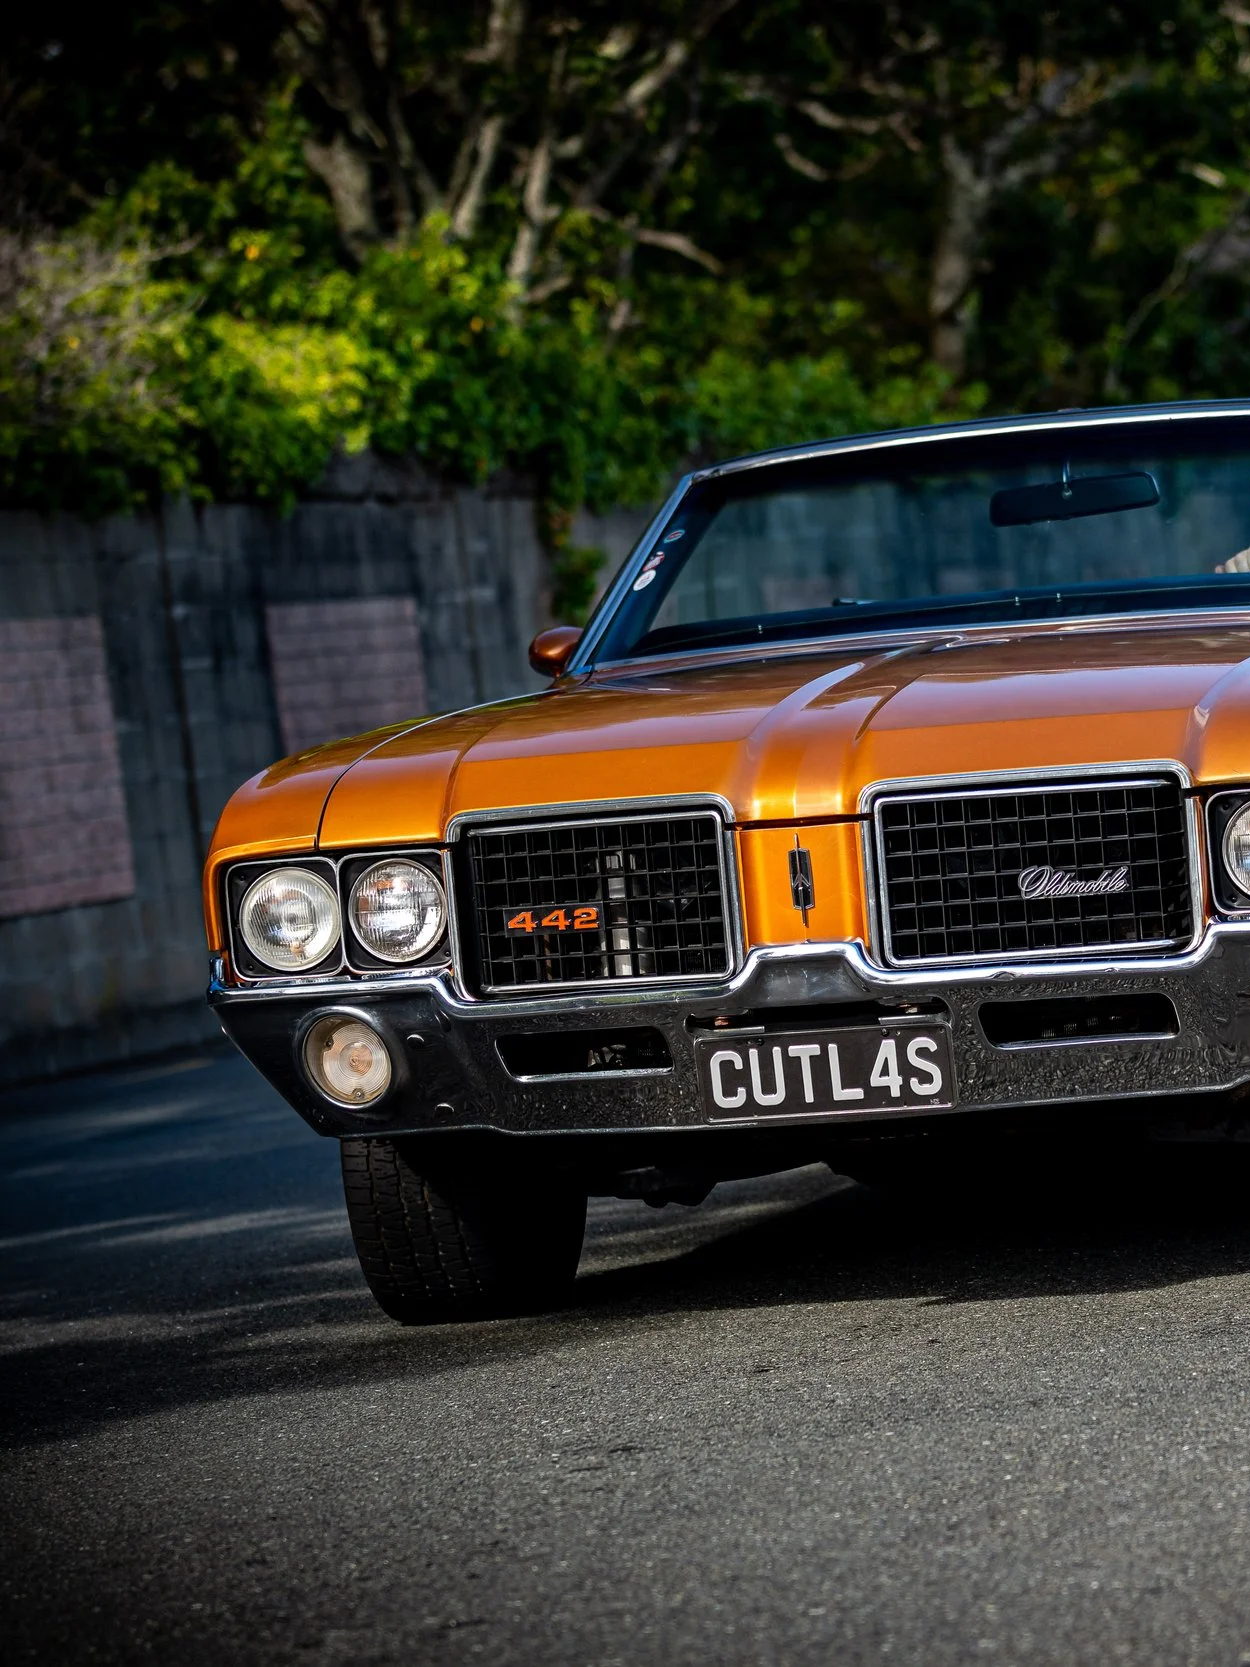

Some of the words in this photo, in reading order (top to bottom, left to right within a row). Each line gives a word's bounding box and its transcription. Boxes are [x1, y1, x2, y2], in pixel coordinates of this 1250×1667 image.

[1018, 865, 1129, 899] Oldsmobile
[507, 906, 600, 933] 442
[710, 1037, 943, 1108] CUTL4S
